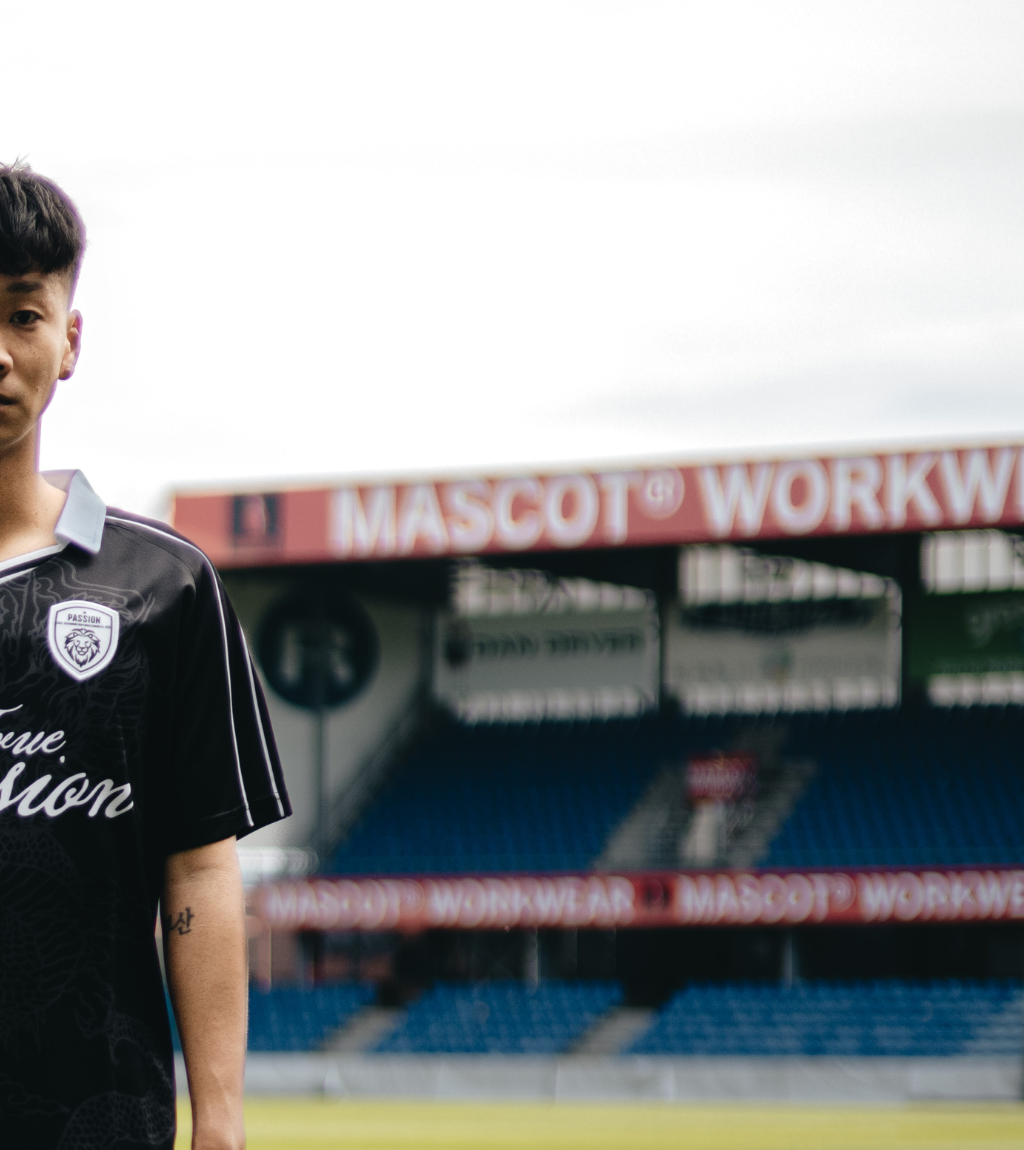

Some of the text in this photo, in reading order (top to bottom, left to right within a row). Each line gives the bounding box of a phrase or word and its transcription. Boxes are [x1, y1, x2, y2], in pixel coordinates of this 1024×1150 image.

[693, 449, 1024, 540] WORKW
[67, 613, 102, 624] PASSION
[165, 906, 195, 935] 산
